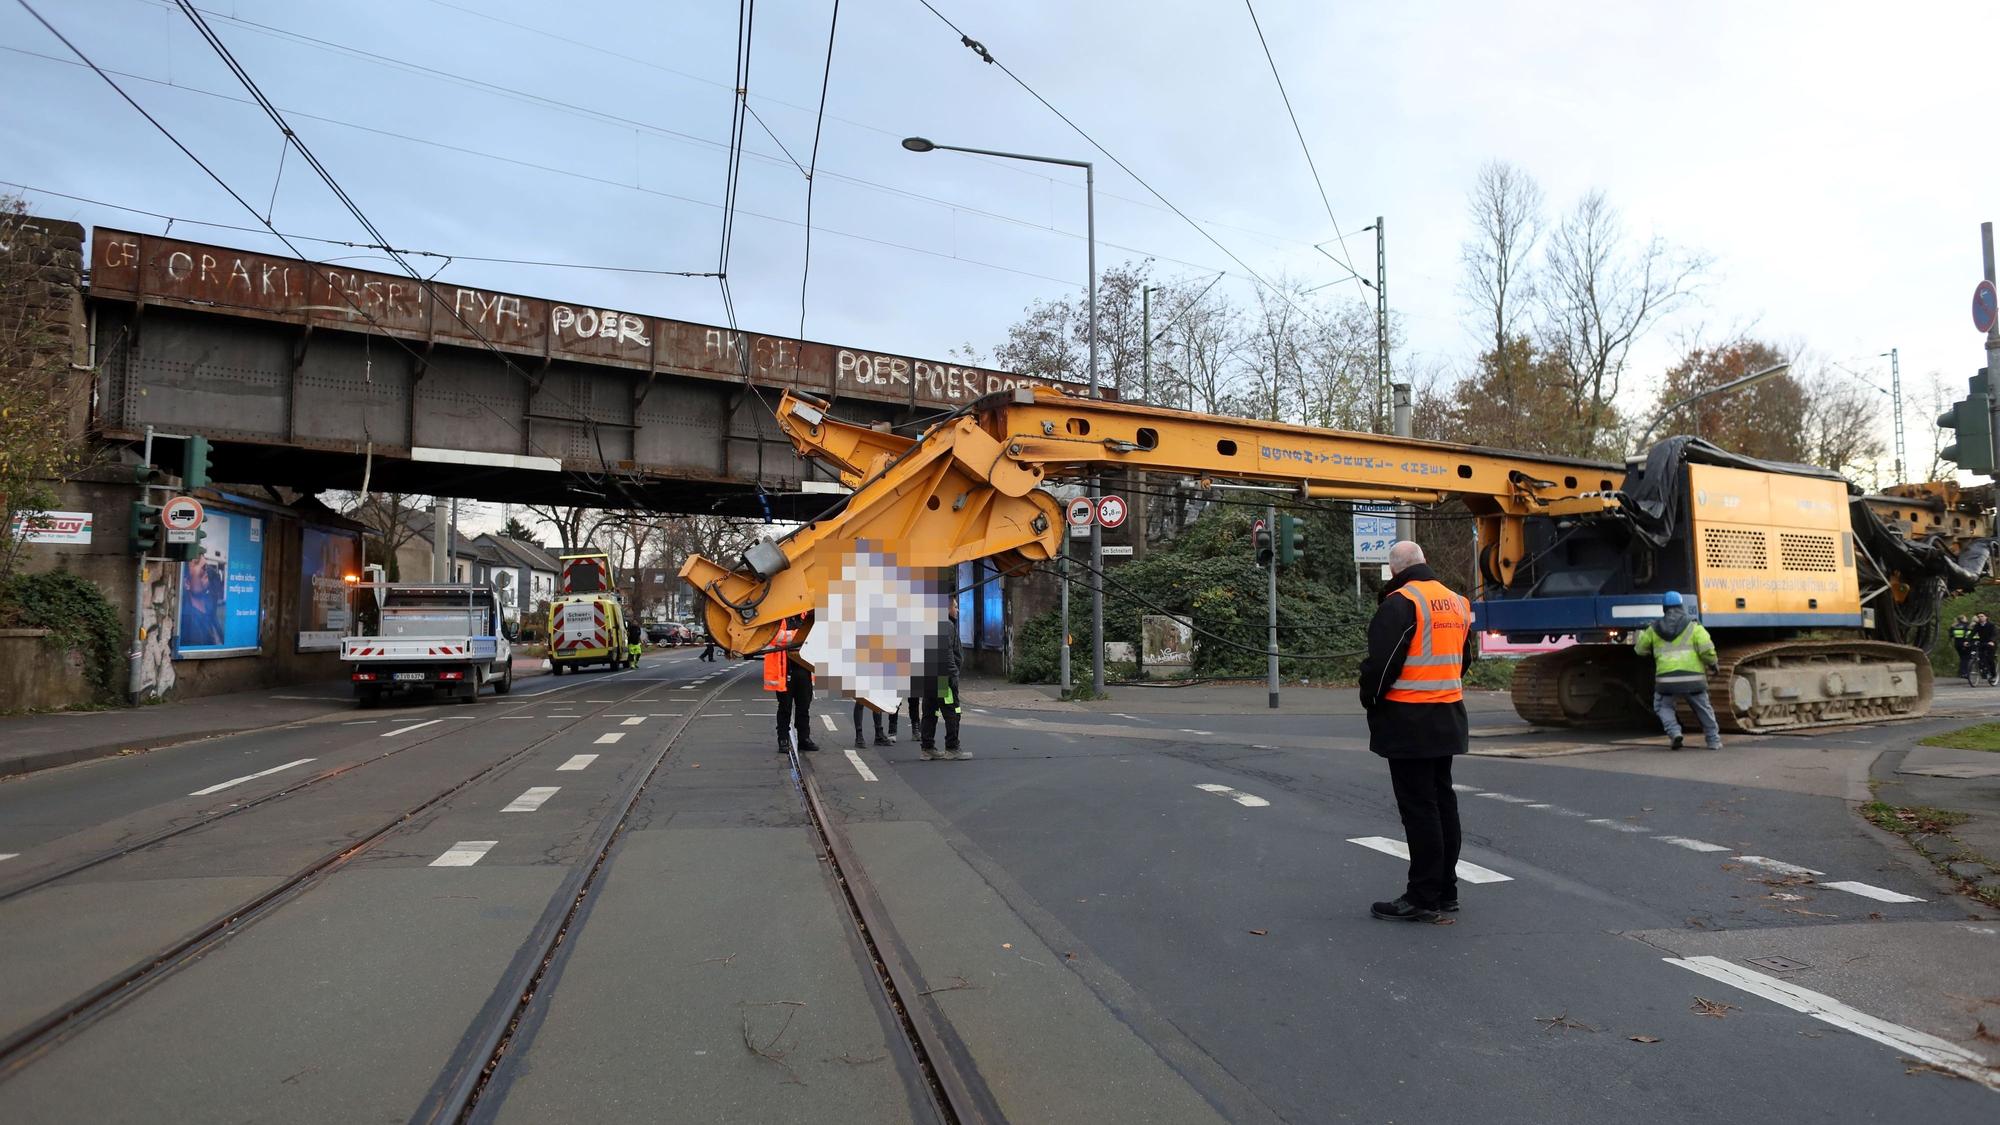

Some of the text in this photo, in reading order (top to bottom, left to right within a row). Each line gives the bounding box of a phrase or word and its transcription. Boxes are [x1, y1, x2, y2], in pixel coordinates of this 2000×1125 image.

[552, 305, 651, 348] POER
[838, 350, 910, 385] POER
[914, 361, 985, 399] POER
[1430, 599, 1451, 611] KVB
